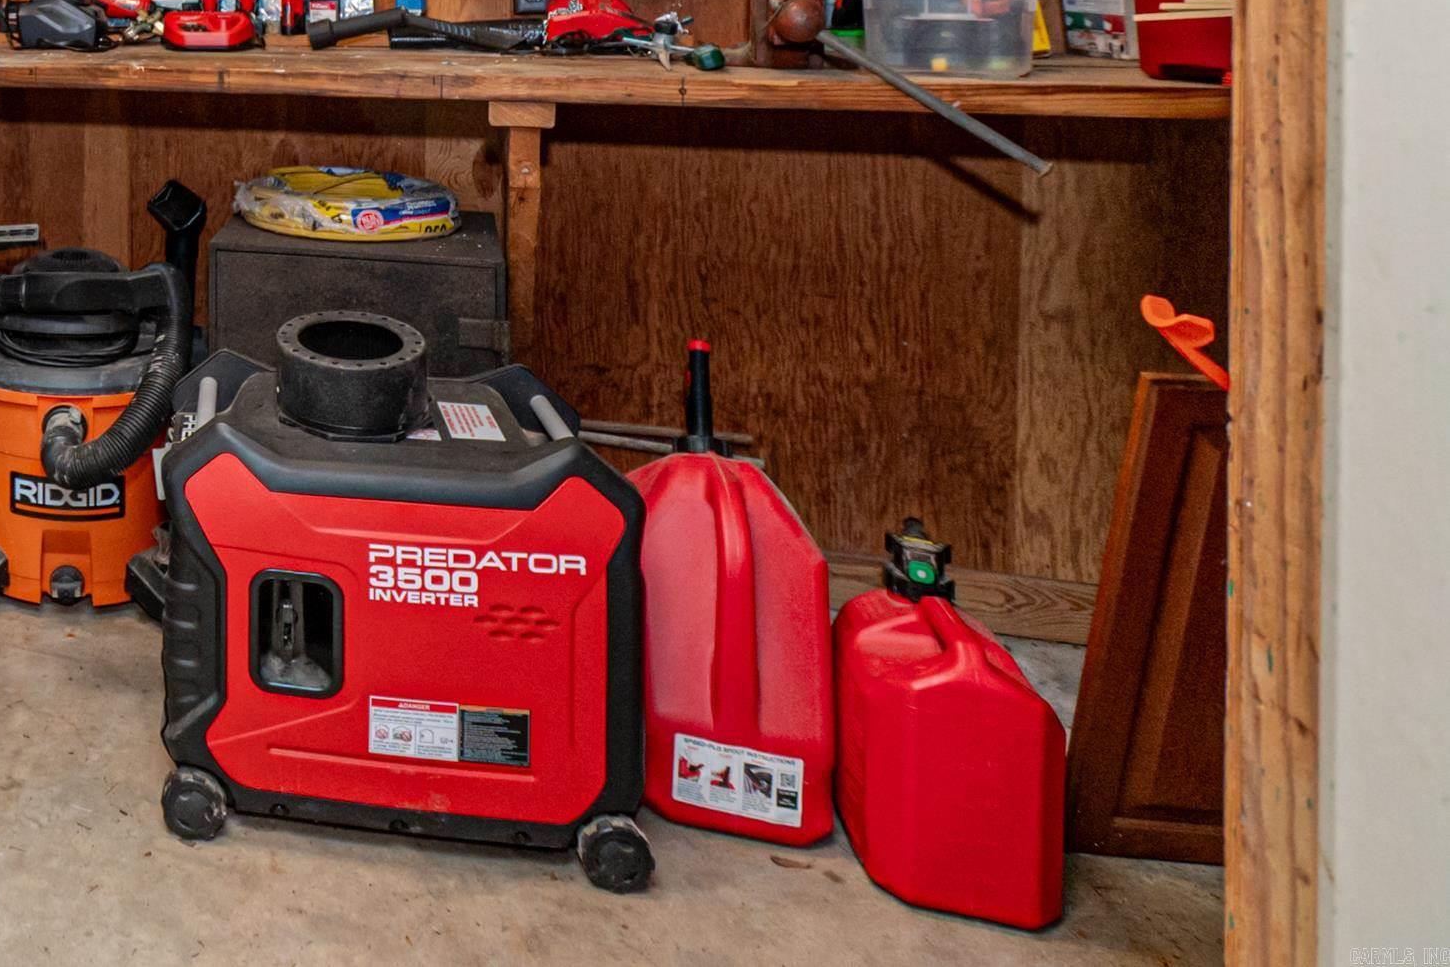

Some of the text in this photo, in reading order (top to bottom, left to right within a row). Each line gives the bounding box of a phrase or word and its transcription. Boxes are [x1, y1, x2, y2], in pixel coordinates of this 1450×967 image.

[14, 477, 120, 507] RIDGID
[368, 543, 587, 576] PREDATOR
[369, 564, 479, 594] 3500
[368, 588, 479, 608] INVERTER
